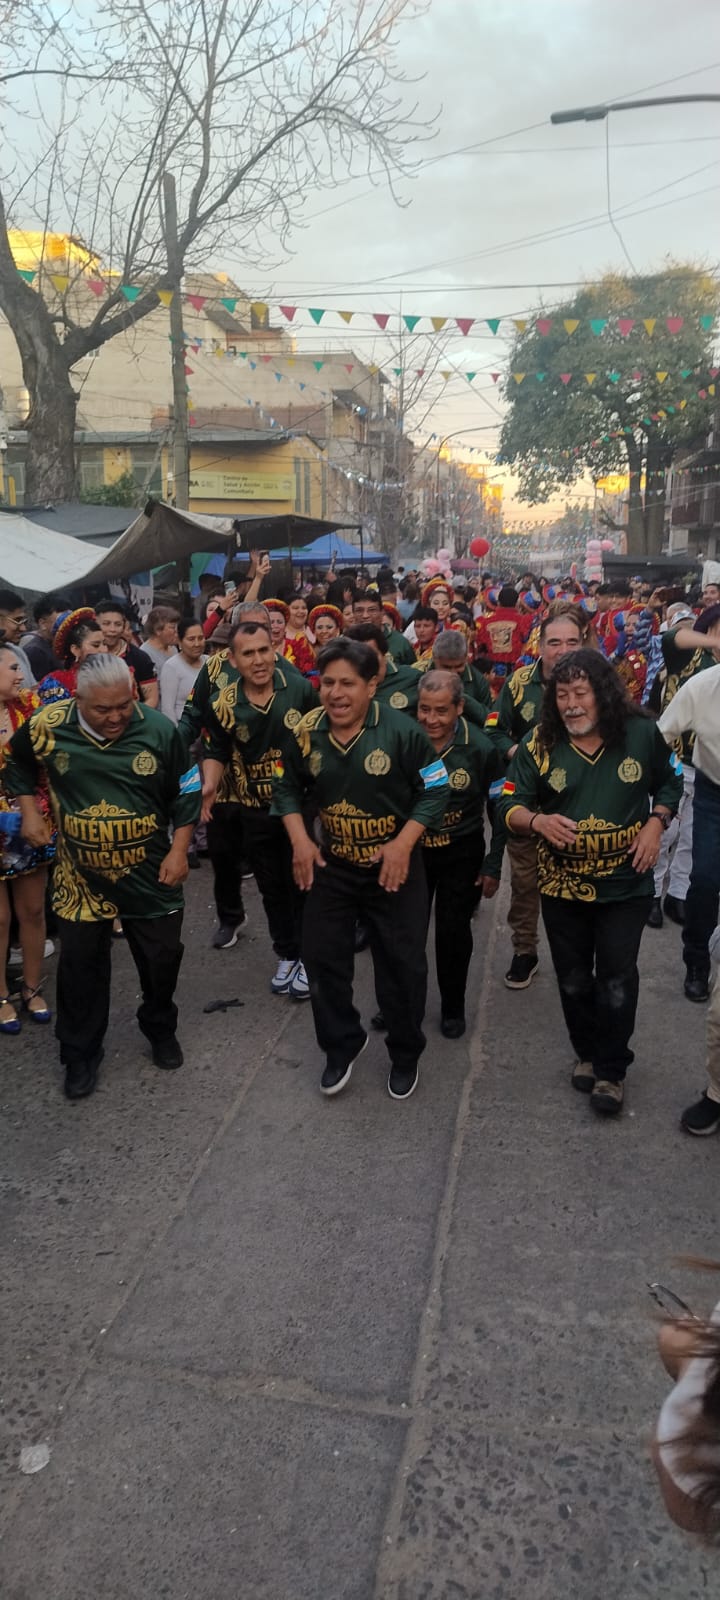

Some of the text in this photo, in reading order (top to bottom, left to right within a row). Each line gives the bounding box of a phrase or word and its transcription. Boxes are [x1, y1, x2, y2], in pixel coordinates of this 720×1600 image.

[138, 756, 152, 769] 50
[371, 756, 383, 767] 50
[624, 764, 637, 776] 50
[453, 773, 466, 784] 50
[64, 813, 159, 842] AUTÉNTICOS
[101, 843, 115, 851] DE
[77, 846, 147, 869] LUGANO
